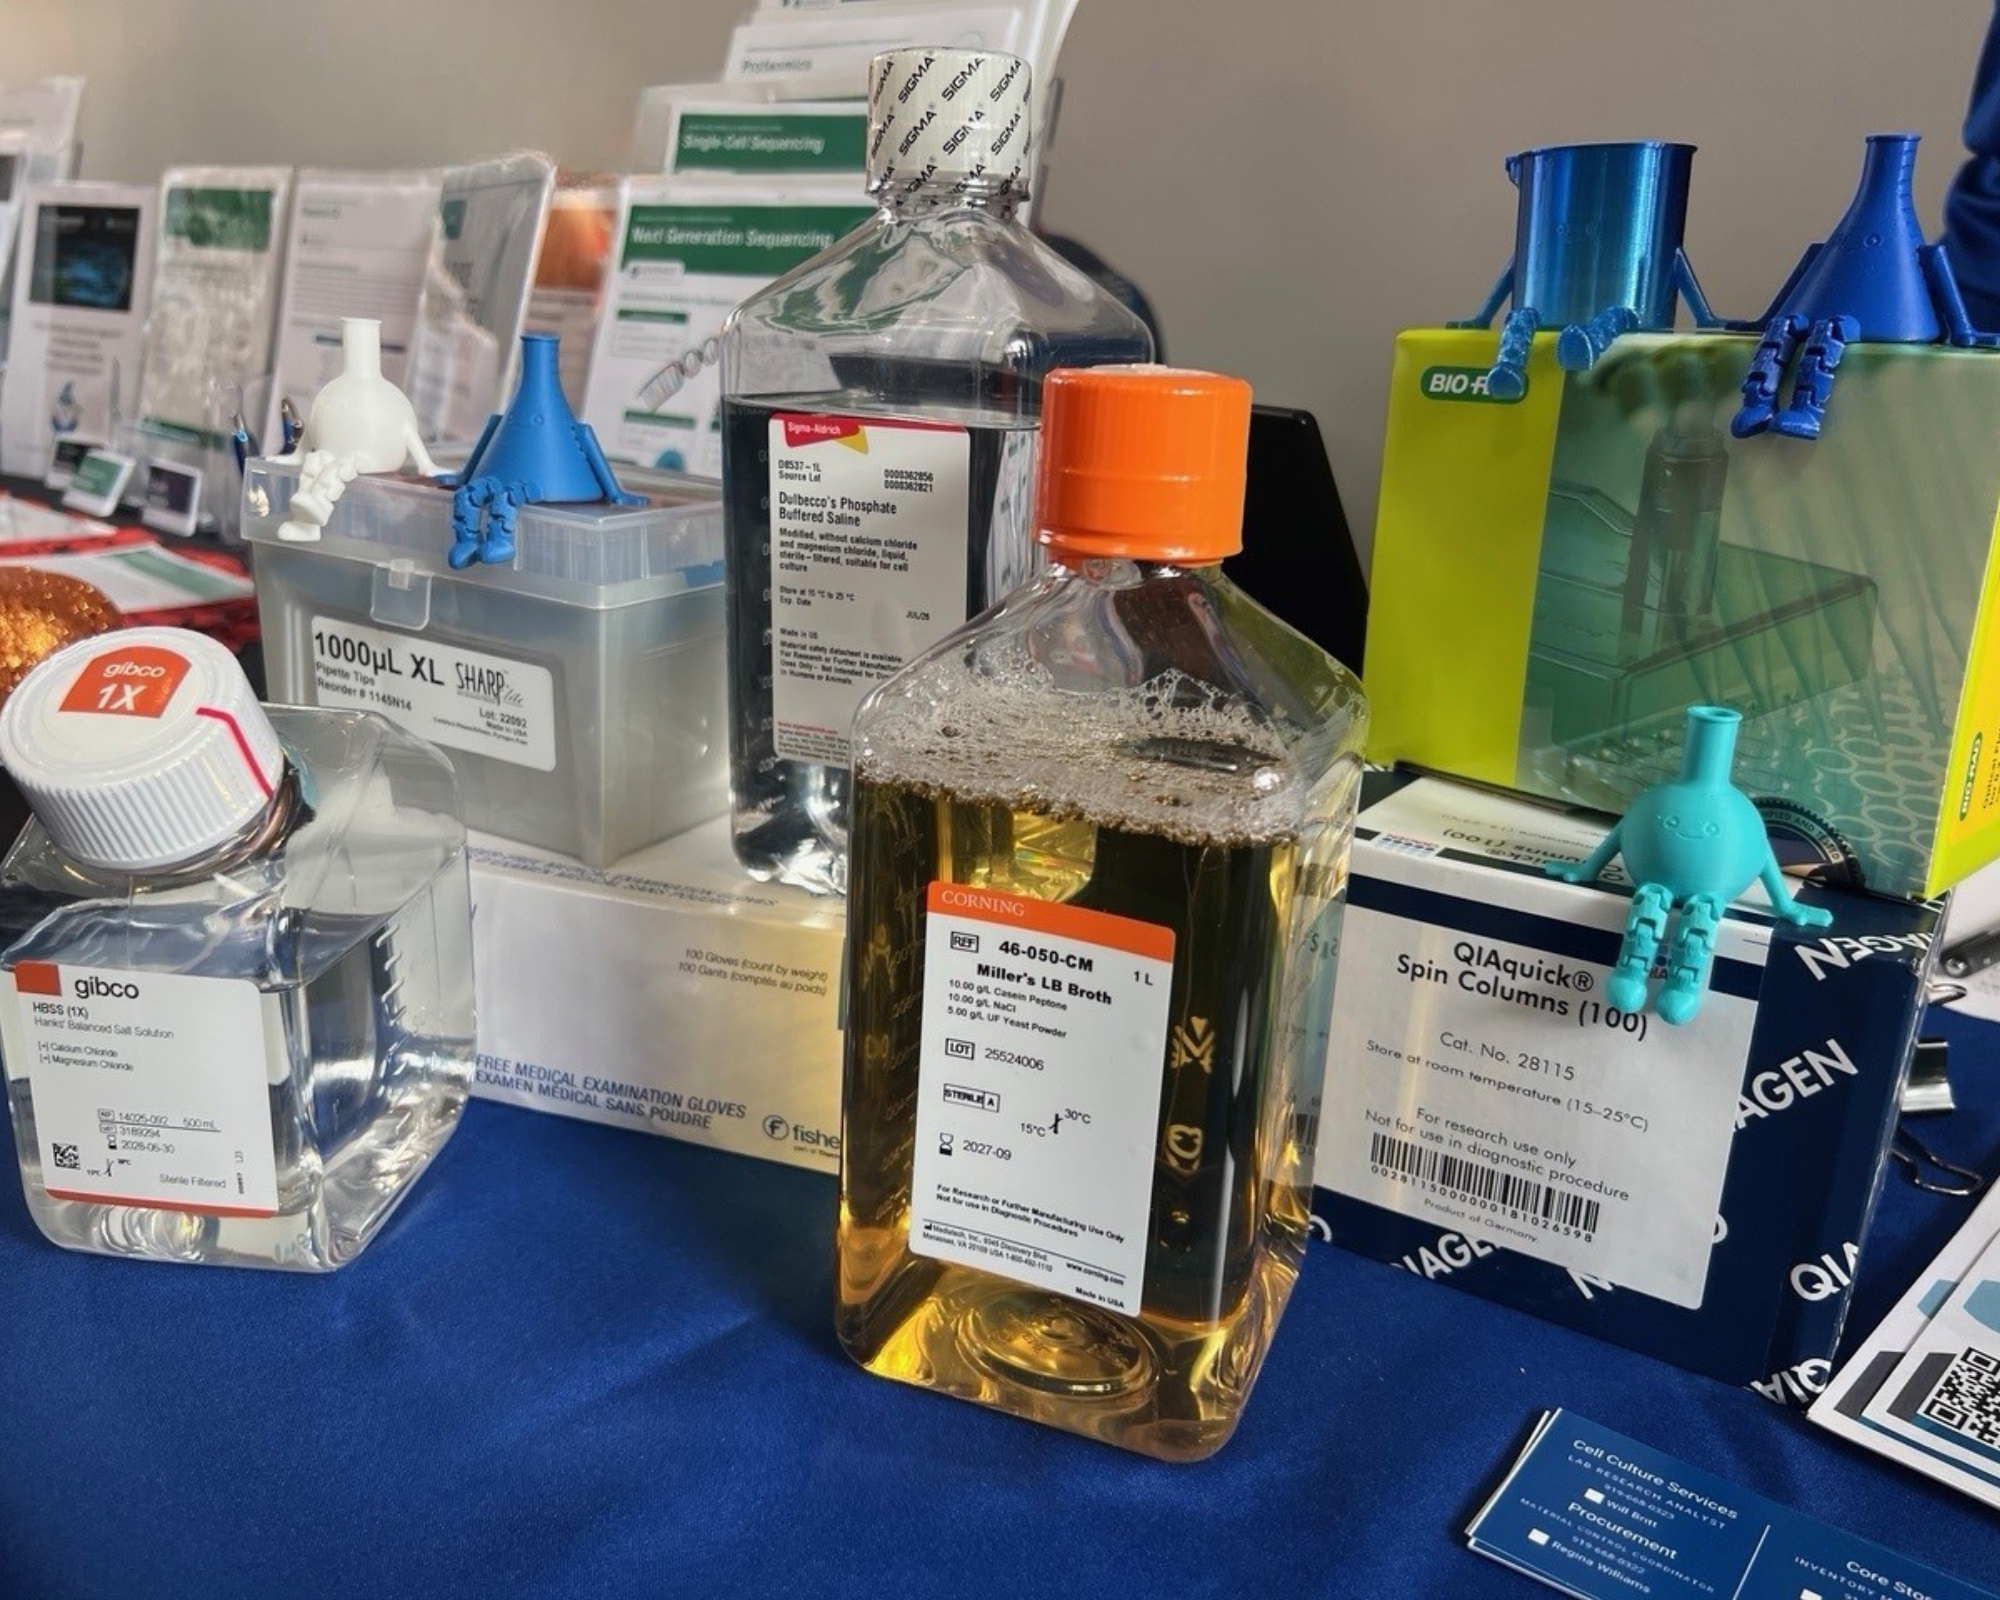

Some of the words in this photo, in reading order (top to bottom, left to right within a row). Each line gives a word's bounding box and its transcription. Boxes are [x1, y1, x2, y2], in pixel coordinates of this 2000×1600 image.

[898, 57, 935, 104] SIGMA
[942, 58, 985, 101] SIGMA
[990, 60, 1021, 102] SIGMA
[898, 110, 937, 156] SIGMA
[991, 112, 1021, 155] SIGMA
[666, 227, 743, 245] Generation
[745, 229, 834, 249] Sequencing
[788, 423, 841, 435] Sigma-Aldrich
[779, 471, 807, 481] Source
[780, 492, 837, 509] Dulbecco's
[841, 496, 897, 514] Phosphate
[780, 509, 824, 524] Buffered
[827, 511, 861, 527] Saline
[780, 539, 794, 549] and
[797, 541, 841, 554] magnesium
[820, 532, 848, 543] without
[884, 538, 917, 550] chloride
[103, 661, 166, 678] gibco
[316, 662, 350, 680] Pipette
[353, 670, 375, 687] Tips
[411, 652, 445, 686] XL
[456, 662, 505, 706] SHARP
[97, 683, 147, 711] 1X
[317, 678, 357, 695] Reorder
[942, 890, 1025, 917] CORNING
[678, 962, 696, 975] 100
[698, 965, 729, 980] Gants
[685, 948, 703, 962] 100
[705, 950, 739, 967] Gloves
[741, 956, 774, 974] (count
[775, 963, 789, 979] by
[954, 935, 976, 949] REF
[999, 940, 1094, 973] 46-050-CM
[1145, 974, 1153, 986] L
[1453, 941, 1595, 992] QIAquick®
[74, 976, 139, 999] gibco
[949, 979, 974, 992] 10.00
[976, 984, 992, 996] g/L
[994, 987, 1027, 1002] Casein
[1029, 994, 1068, 1012] Peptone
[977, 963, 1036, 987] Miller's
[1042, 977, 1063, 993] LB
[1068, 983, 1112, 1005] Broth
[1397, 953, 1448, 984] Spin
[1458, 971, 1569, 1016] Columns
[1578, 1000, 1648, 1042] (100)
[33, 1002, 64, 1016] HBSS
[67, 1006, 89, 1020] (1X)
[949, 993, 974, 1005] 10.00
[976, 997, 991, 1010] g/L
[993, 1001, 1017, 1013] NaCl
[68, 1020, 112, 1034] Balanced
[114, 1024, 132, 1036] Salt
[135, 1026, 174, 1039] Solution
[948, 1005, 968, 1017] 5.00
[970, 1010, 985, 1023] g/L
[987, 1013, 1001, 1024] UF
[1003, 1017, 1029, 1032] Yeast
[1031, 1022, 1068, 1039] Powder
[50, 1042, 83, 1055] Calcium
[84, 1046, 118, 1058] Chloride
[52, 1055, 98, 1068] Magnesium
[100, 1058, 134, 1072] Chloride
[949, 1042, 970, 1056] LOT
[984, 1048, 1044, 1071] 25524006
[1440, 1031, 1473, 1053] Cat.
[1480, 1042, 1510, 1064] No.
[1518, 1053, 1575, 1081] 28115
[476, 1055, 510, 1073] FREE
[515, 1061, 577, 1088] MEDICAL
[582, 1077, 682, 1108] EXAMINATION
[688, 1095, 747, 1120] GLOVES
[1367, 1040, 1402, 1060] Store
[1407, 1052, 1422, 1065] at
[1425, 1059, 1464, 1078] room
[1469, 1071, 1561, 1106] temperature
[476, 1071, 534, 1093] EXAMEN
[606, 1097, 645, 1117] SANS
[651, 1106, 713, 1130] POUDRE
[945, 1088, 984, 1105] STERILE
[1020, 1122, 1046, 1137] 15°C
[1064, 1108, 1091, 1124] 30°C
[963, 1139, 1012, 1160] 2027-09
[1416, 1107, 1440, 1125] For
[1445, 1117, 1508, 1146] research
[1513, 1139, 1539, 1156] use
[1544, 1148, 1577, 1168] only
[1364, 1109, 1391, 1129] Not
[1395, 1118, 1415, 1135] for
[1419, 1129, 1444, 1145] use
[1449, 1134, 1463, 1150] in
[1467, 1140, 1544, 1176] diagnostic
[1549, 1168, 1630, 1202] procedure
[160, 1173, 189, 1186] Sterile
[191, 1176, 226, 1188] Filtered
[936, 1193, 950, 1202] Not
[952, 1196, 964, 1206] for
[965, 1201, 979, 1210] use
[991, 1205, 1031, 1224] Diagnostic
[1033, 1216, 1079, 1238] Procedures
[937, 1184, 950, 1193] For
[953, 1187, 990, 1201] Research
[1002, 1199, 1030, 1214] Further
[1032, 1207, 1087, 1231] Manufacturing
[1088, 1224, 1104, 1236] Use
[1106, 1229, 1125, 1244] Only
[1424, 1198, 1466, 1218] Product
[1469, 1215, 1481, 1223] of
[1484, 1217, 1538, 1243] Germany
[1075, 1286, 1097, 1300] Made
[1107, 1296, 1124, 1309] USA
[1568, 1454, 1592, 1470] LAB
[1595, 1466, 1662, 1503] RESEARCH
[1666, 1498, 1726, 1531] ANALYST
[1573, 1439, 1604, 1459] Cell
[1606, 1453, 1666, 1486] Culture
[1667, 1478, 1738, 1520] Services
[1605, 1498, 1634, 1519] Will
[1634, 1509, 1658, 1529] Britt
[1520, 1497, 1573, 1528] MATERIAL
[1577, 1524, 1628, 1553] CONTROL
[1631, 1550, 1715, 1594] COORDINATOR
[1568, 1501, 1678, 1560] Procurement
[1551, 1540, 1595, 1566] Regina
[1597, 1561, 1651, 1594] Williams
[1794, 1556, 1875, 1596] INVENTORY
[1846, 1561, 1889, 1586] Core
